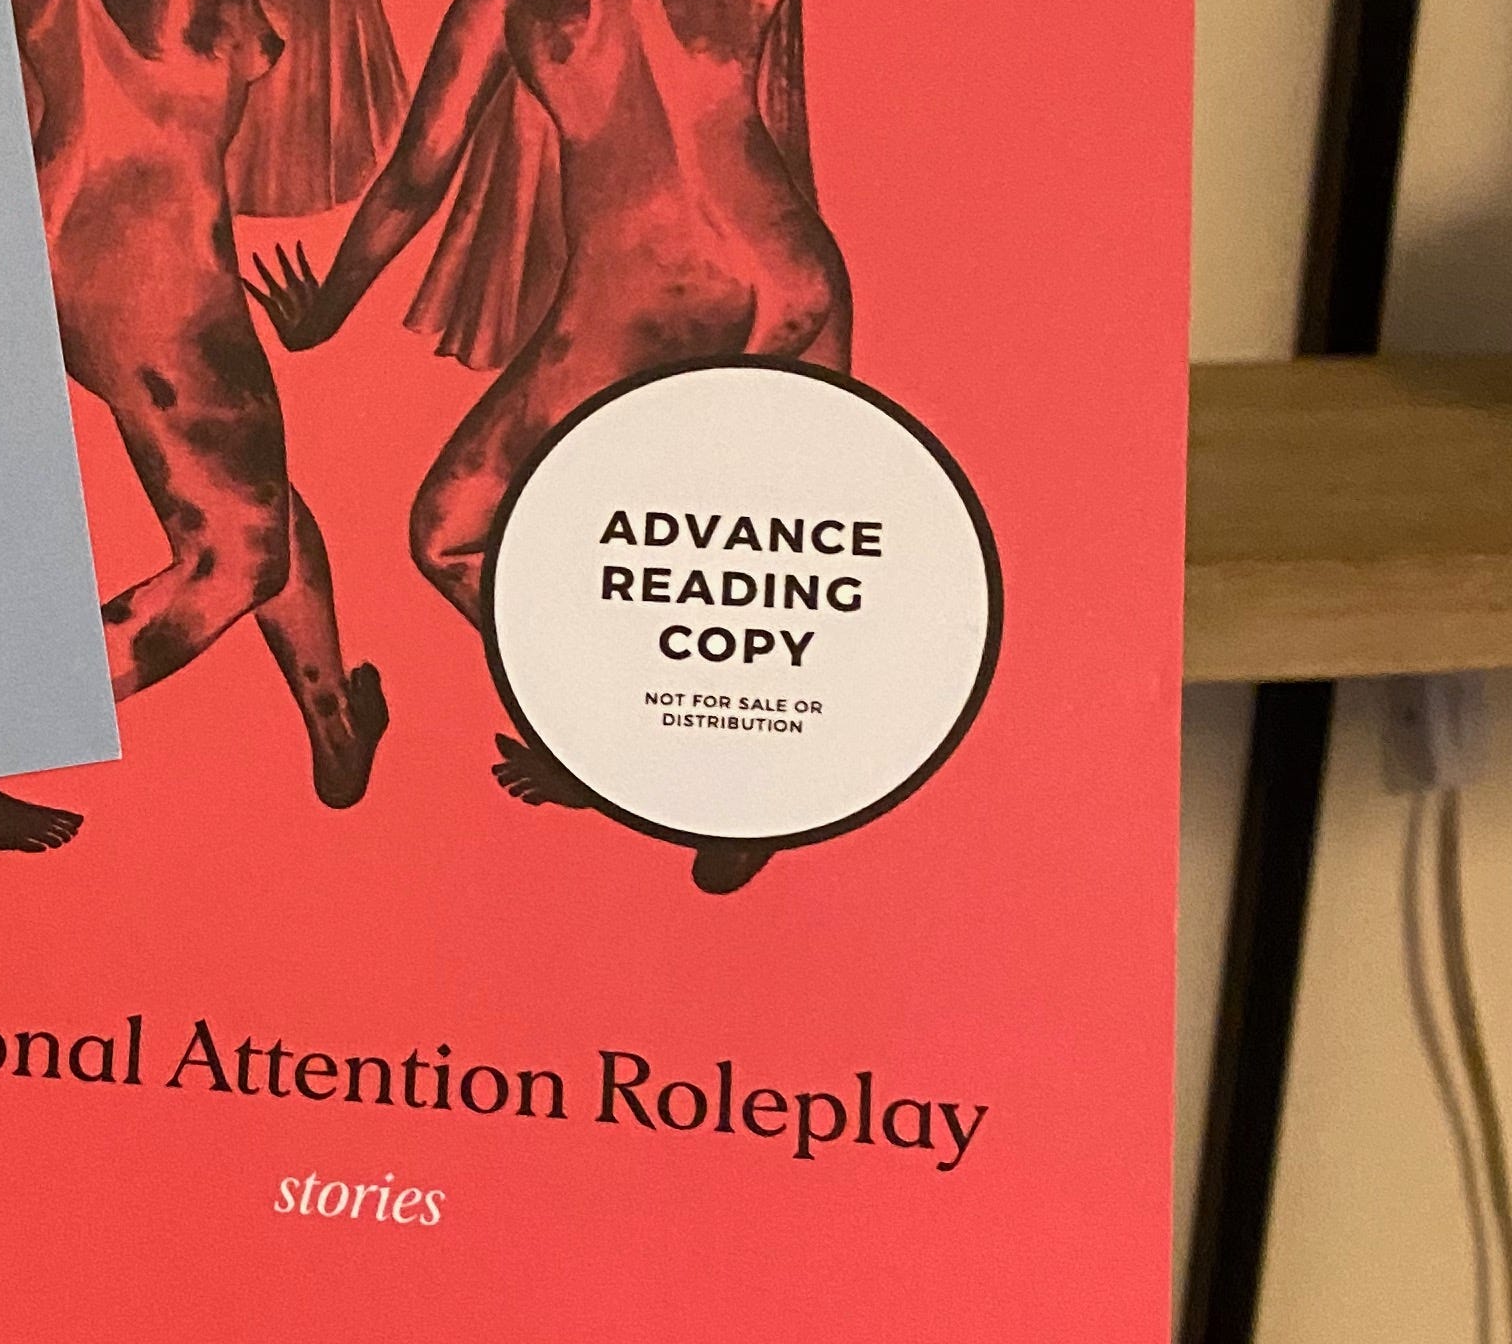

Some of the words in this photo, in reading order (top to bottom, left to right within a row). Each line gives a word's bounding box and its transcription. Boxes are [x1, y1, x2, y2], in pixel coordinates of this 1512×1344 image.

[599, 509, 883, 558] ADVANCE
[601, 565, 862, 613] READING
[658, 624, 816, 667] COPY
[644, 691, 686, 706] NOT
[692, 694, 731, 709] FOR
[738, 697, 787, 712] SALE
[794, 700, 823, 714] OR
[662, 713, 803, 733] DISTRIBUTION
[165, 1017, 568, 1120] Attention
[594, 1048, 989, 1173] Roleplay
[273, 1169, 446, 1226] stories
